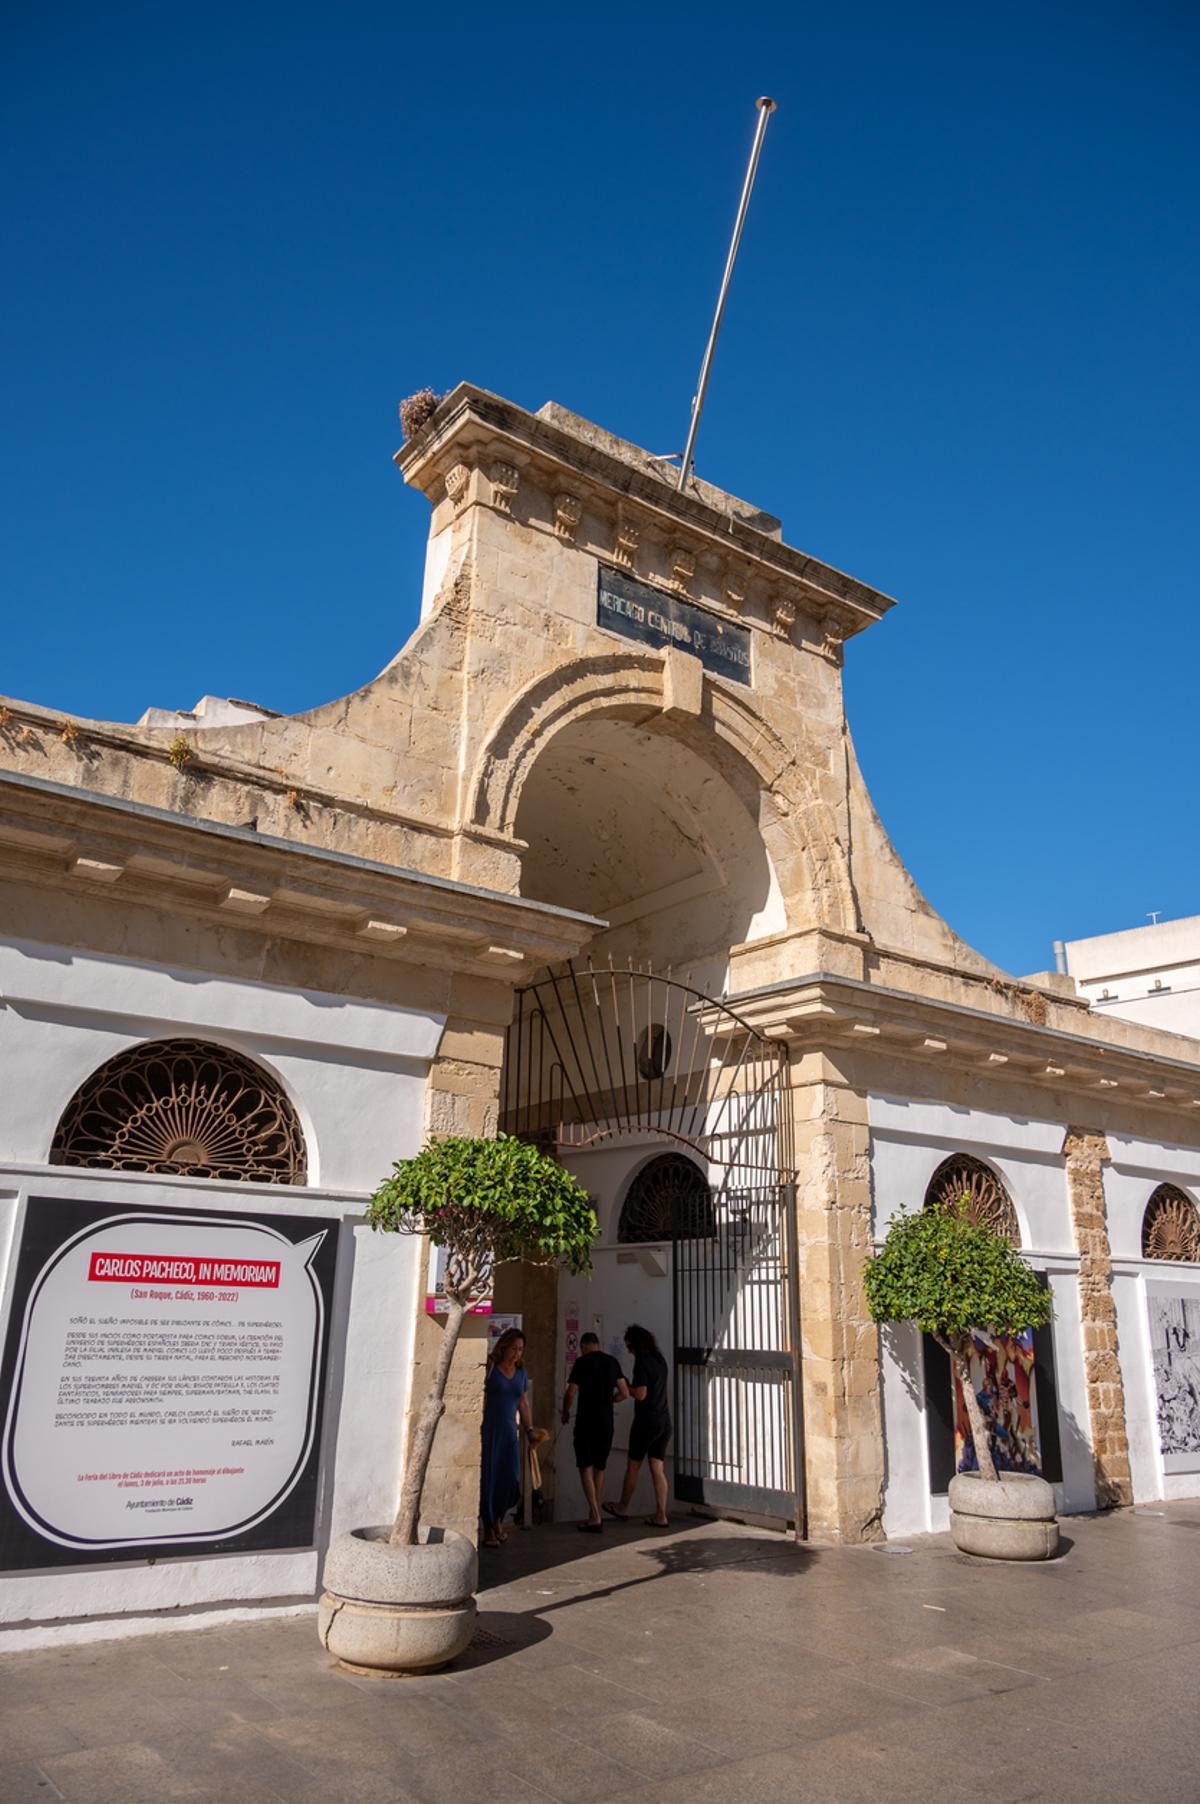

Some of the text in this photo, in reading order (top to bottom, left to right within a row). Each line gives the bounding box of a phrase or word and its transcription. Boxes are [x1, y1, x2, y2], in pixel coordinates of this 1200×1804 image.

[600, 590, 645, 623] MERCADO
[96, 1258, 276, 1282] CARLOS PACHECO, IN MEMORIAM
[130, 1288, 148, 1300] (San
[149, 1290, 173, 1301] Roque,
[126, 1500, 167, 1510] Ayuntamiento
[176, 1497, 193, 1506] Cádiz
